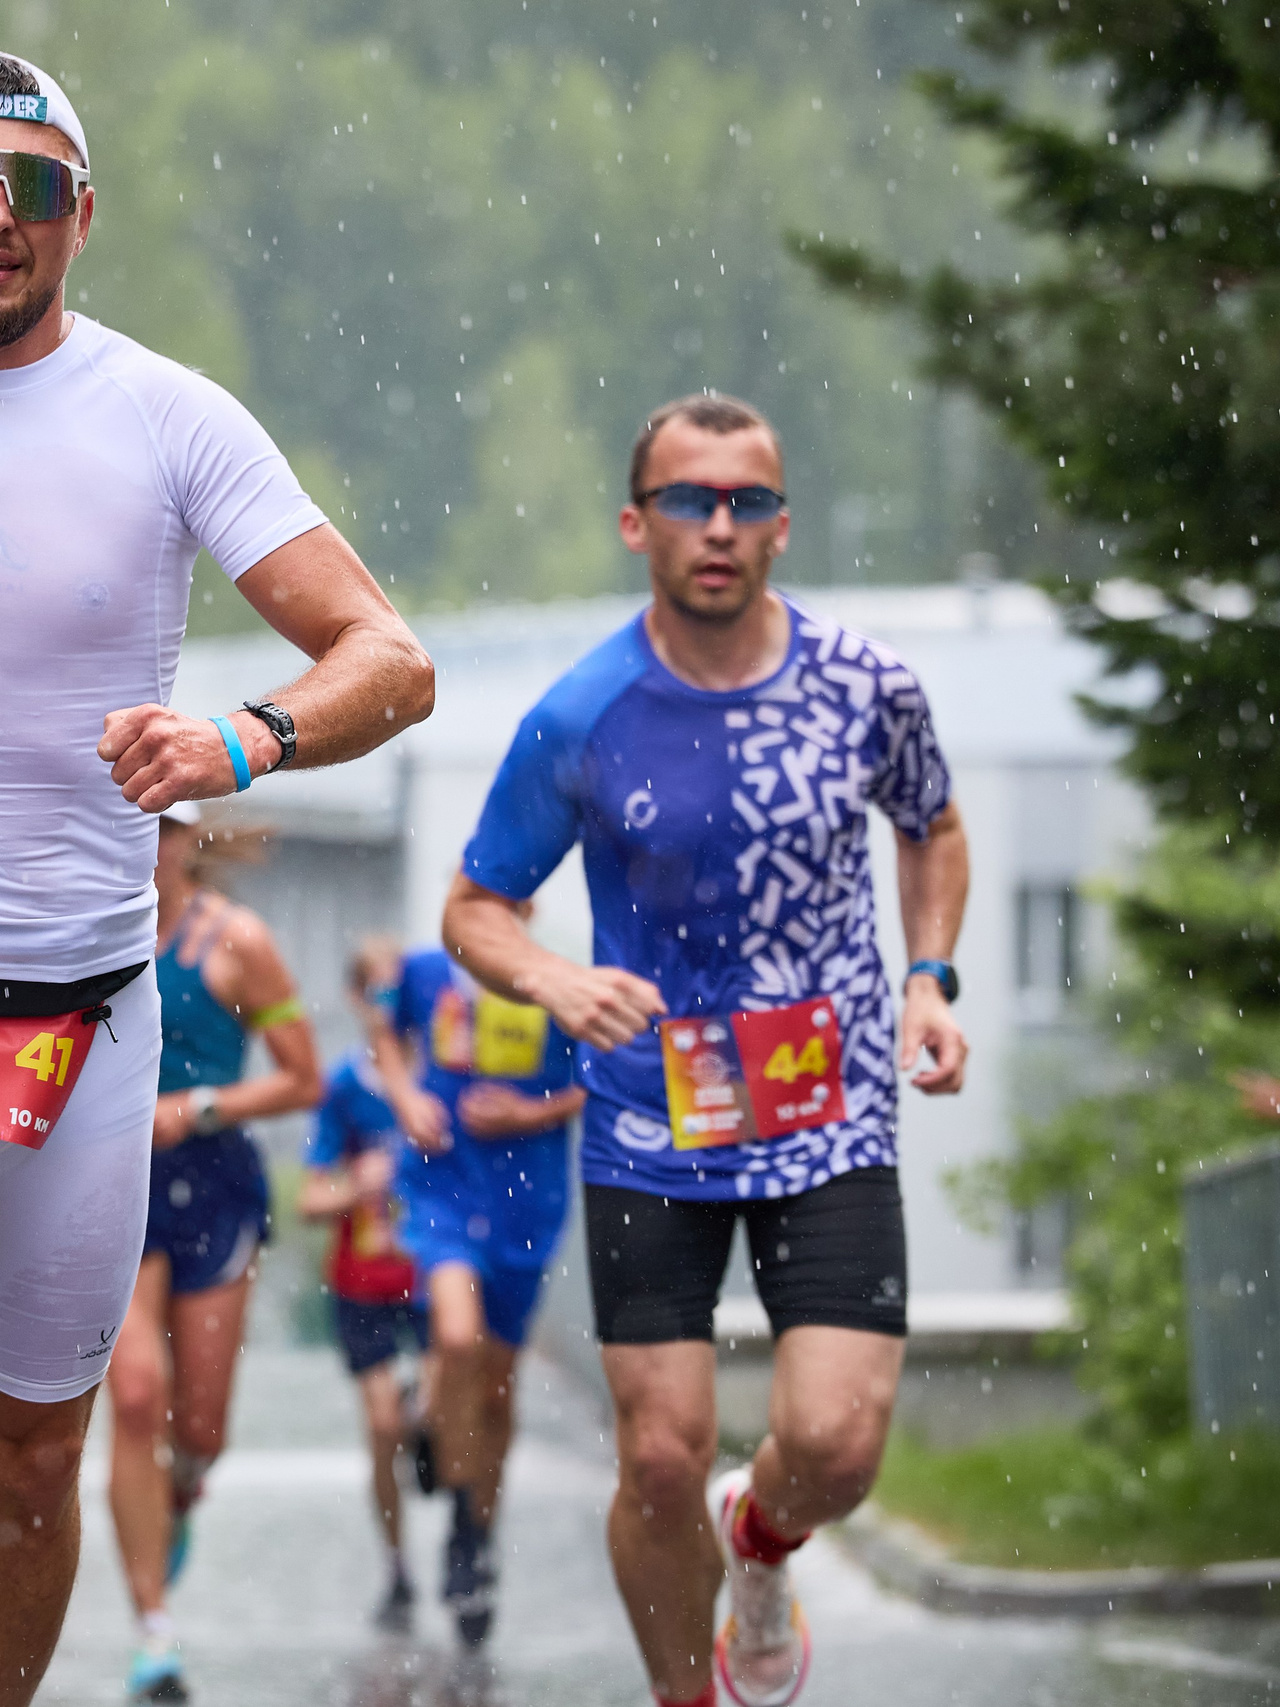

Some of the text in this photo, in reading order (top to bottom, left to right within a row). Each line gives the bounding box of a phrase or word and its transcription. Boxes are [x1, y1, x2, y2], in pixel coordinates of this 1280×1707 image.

[14, 1032, 74, 1087] 41
[763, 1036, 829, 1084] 44
[9, 1107, 32, 1128] 10
